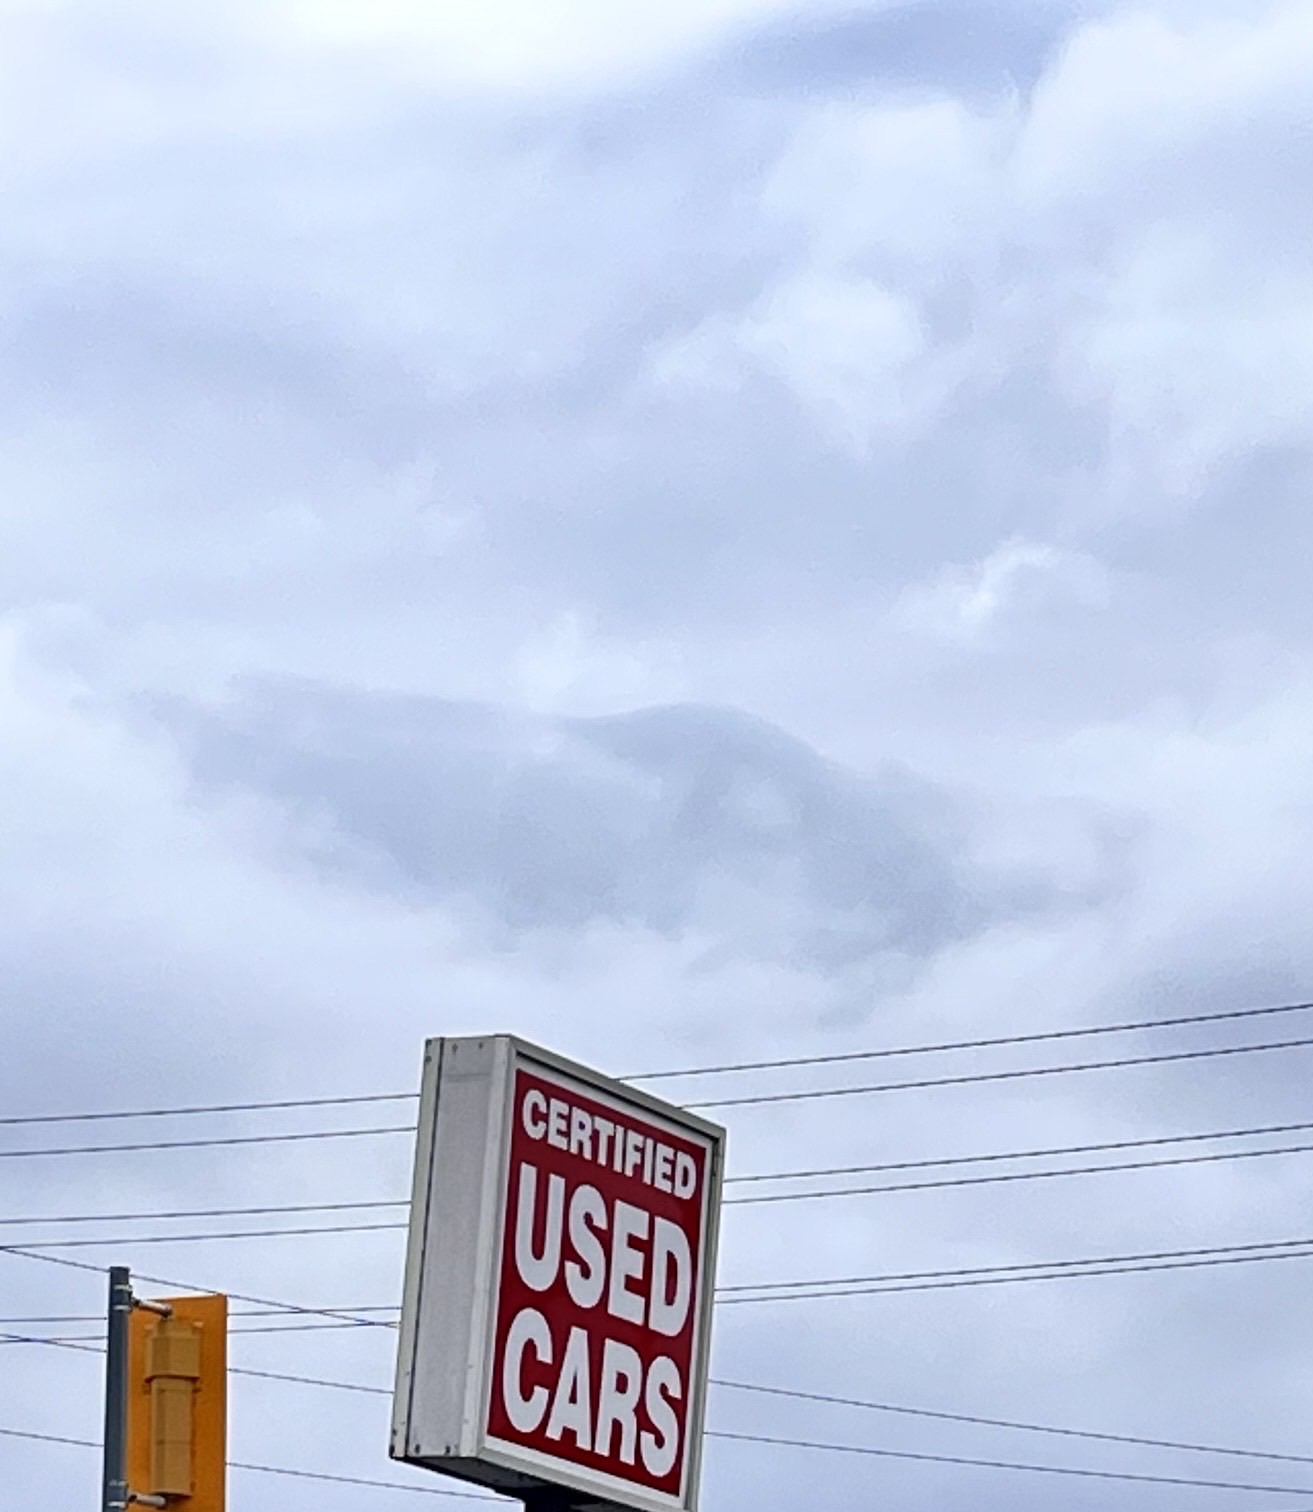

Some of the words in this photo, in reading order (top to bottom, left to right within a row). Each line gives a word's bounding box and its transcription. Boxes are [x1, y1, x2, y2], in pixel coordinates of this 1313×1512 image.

[522, 1089, 696, 1199] CERTIFIED
[514, 1161, 692, 1337] USED
[503, 1307, 682, 1477] CARS
